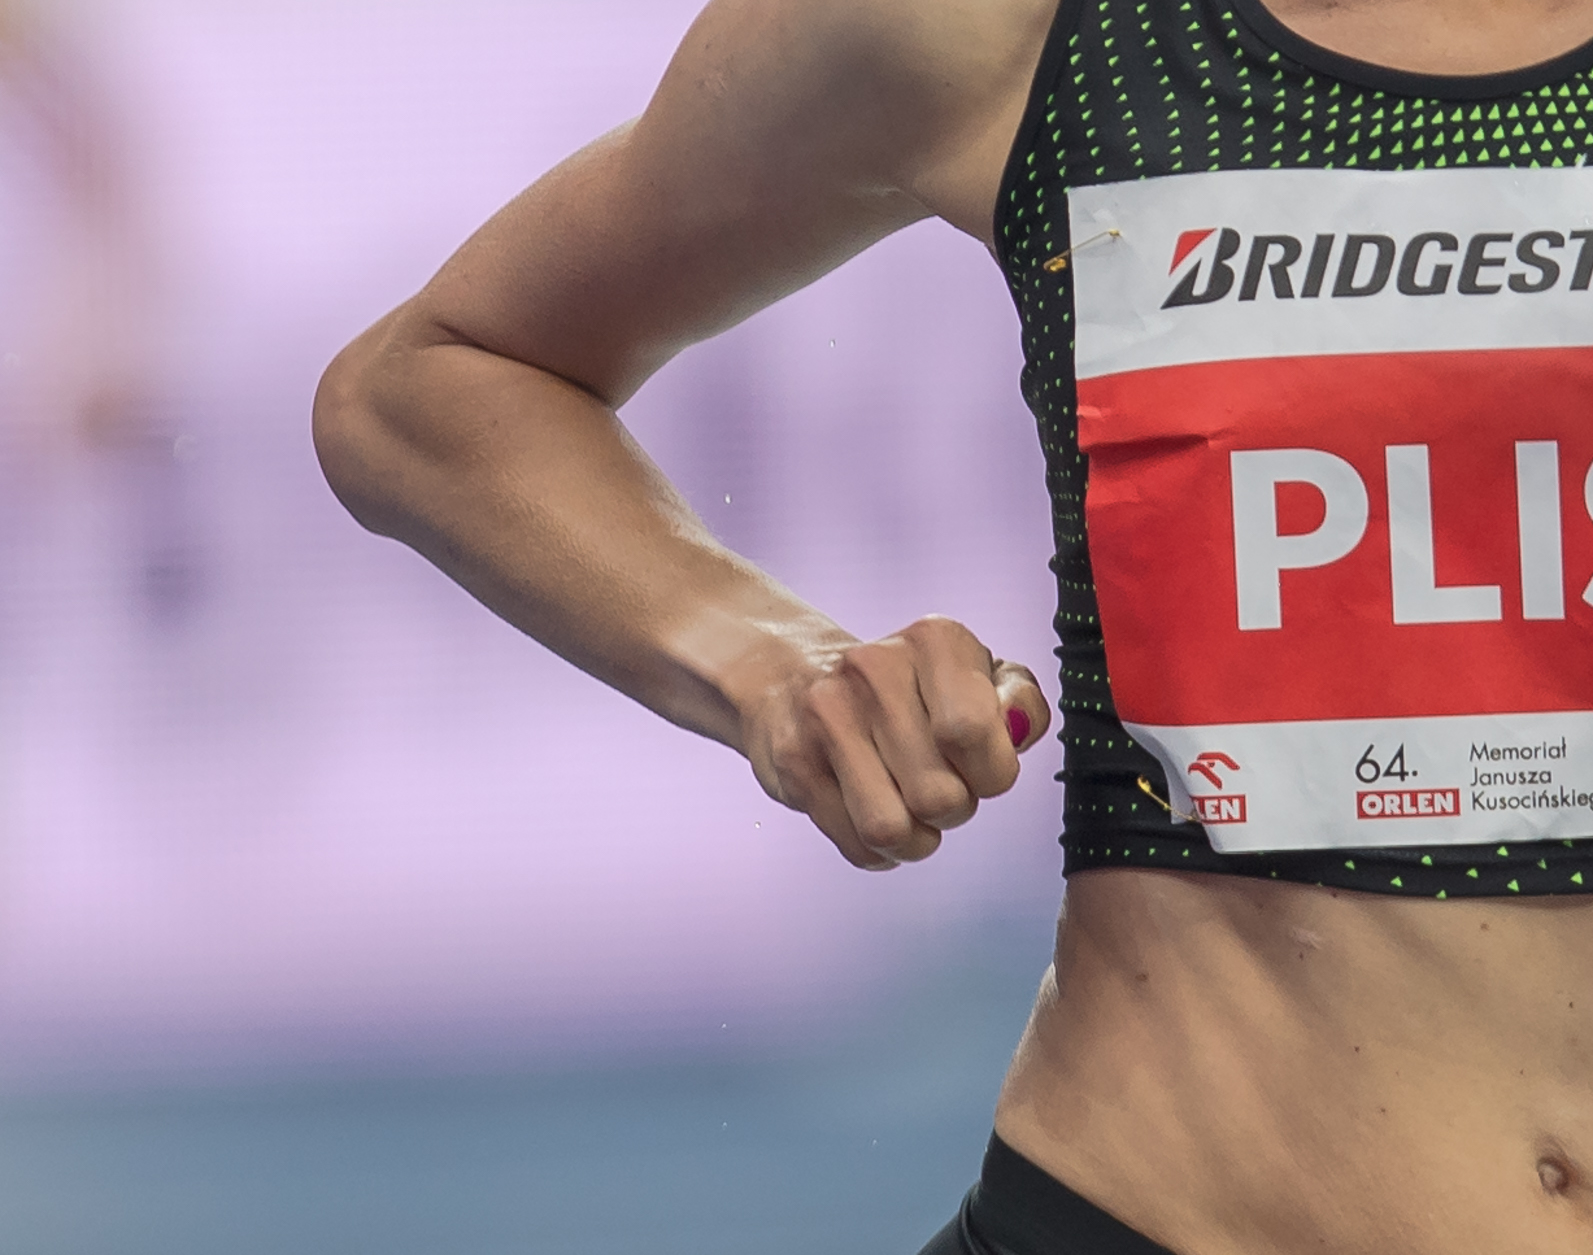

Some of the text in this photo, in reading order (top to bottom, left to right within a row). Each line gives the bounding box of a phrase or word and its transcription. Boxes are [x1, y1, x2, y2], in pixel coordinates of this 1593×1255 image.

[1469, 737, 1567, 762] Memoriał
[1355, 743, 1418, 784] 64.
[1470, 767, 1553, 788] Janusza
[1361, 791, 1455, 816] ORLEN
